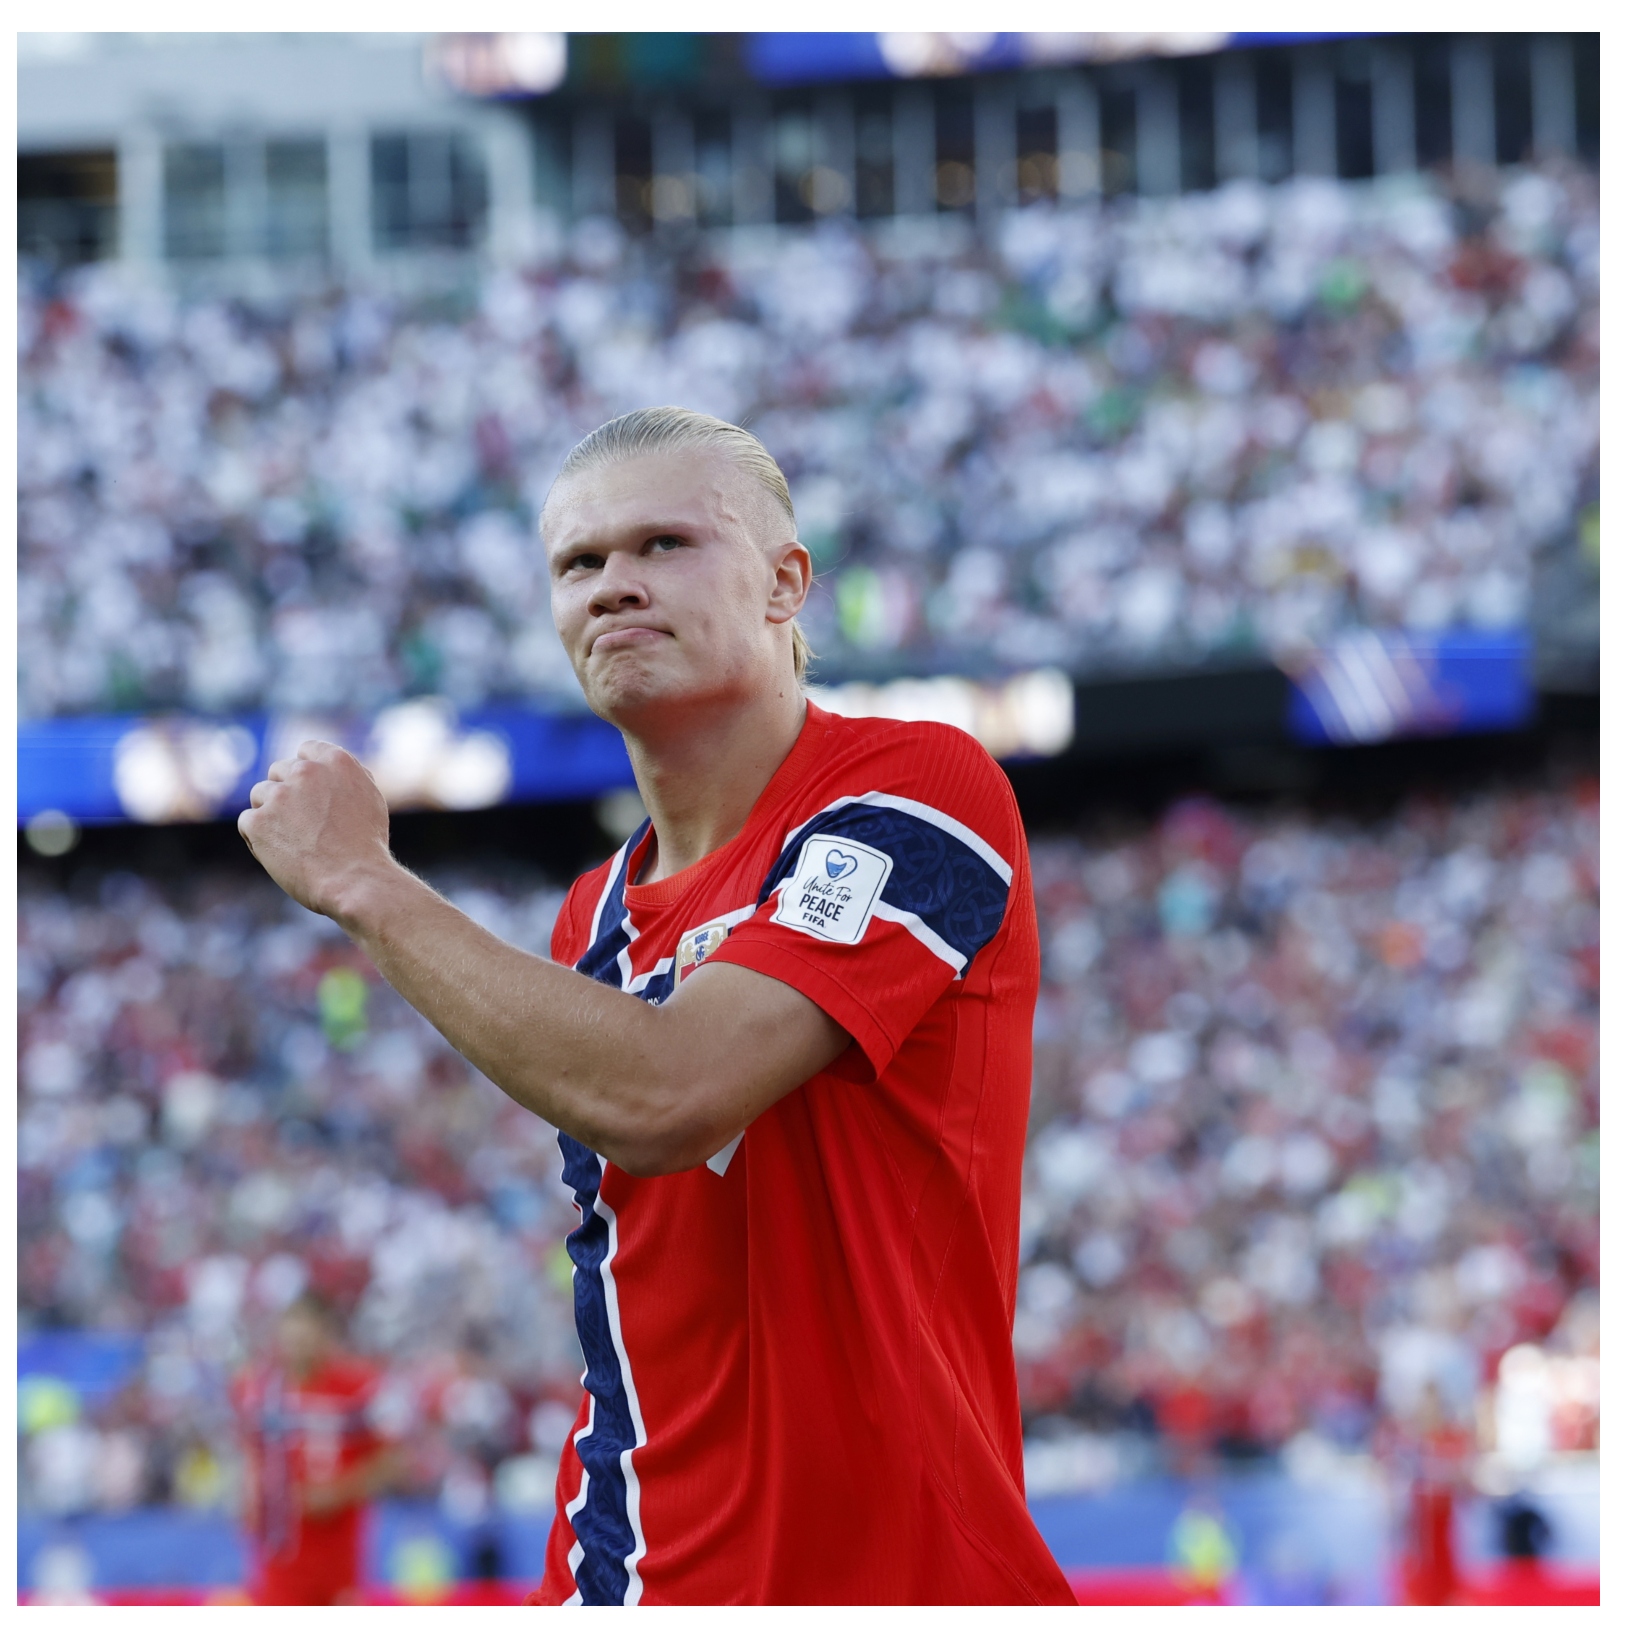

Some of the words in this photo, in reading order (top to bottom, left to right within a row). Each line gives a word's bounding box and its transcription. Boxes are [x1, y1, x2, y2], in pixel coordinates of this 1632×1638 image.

[803, 875, 835, 896] Unite
[834, 886, 853, 902] For
[799, 893, 845, 922] PEACE
[802, 912, 825, 928] FIFA
